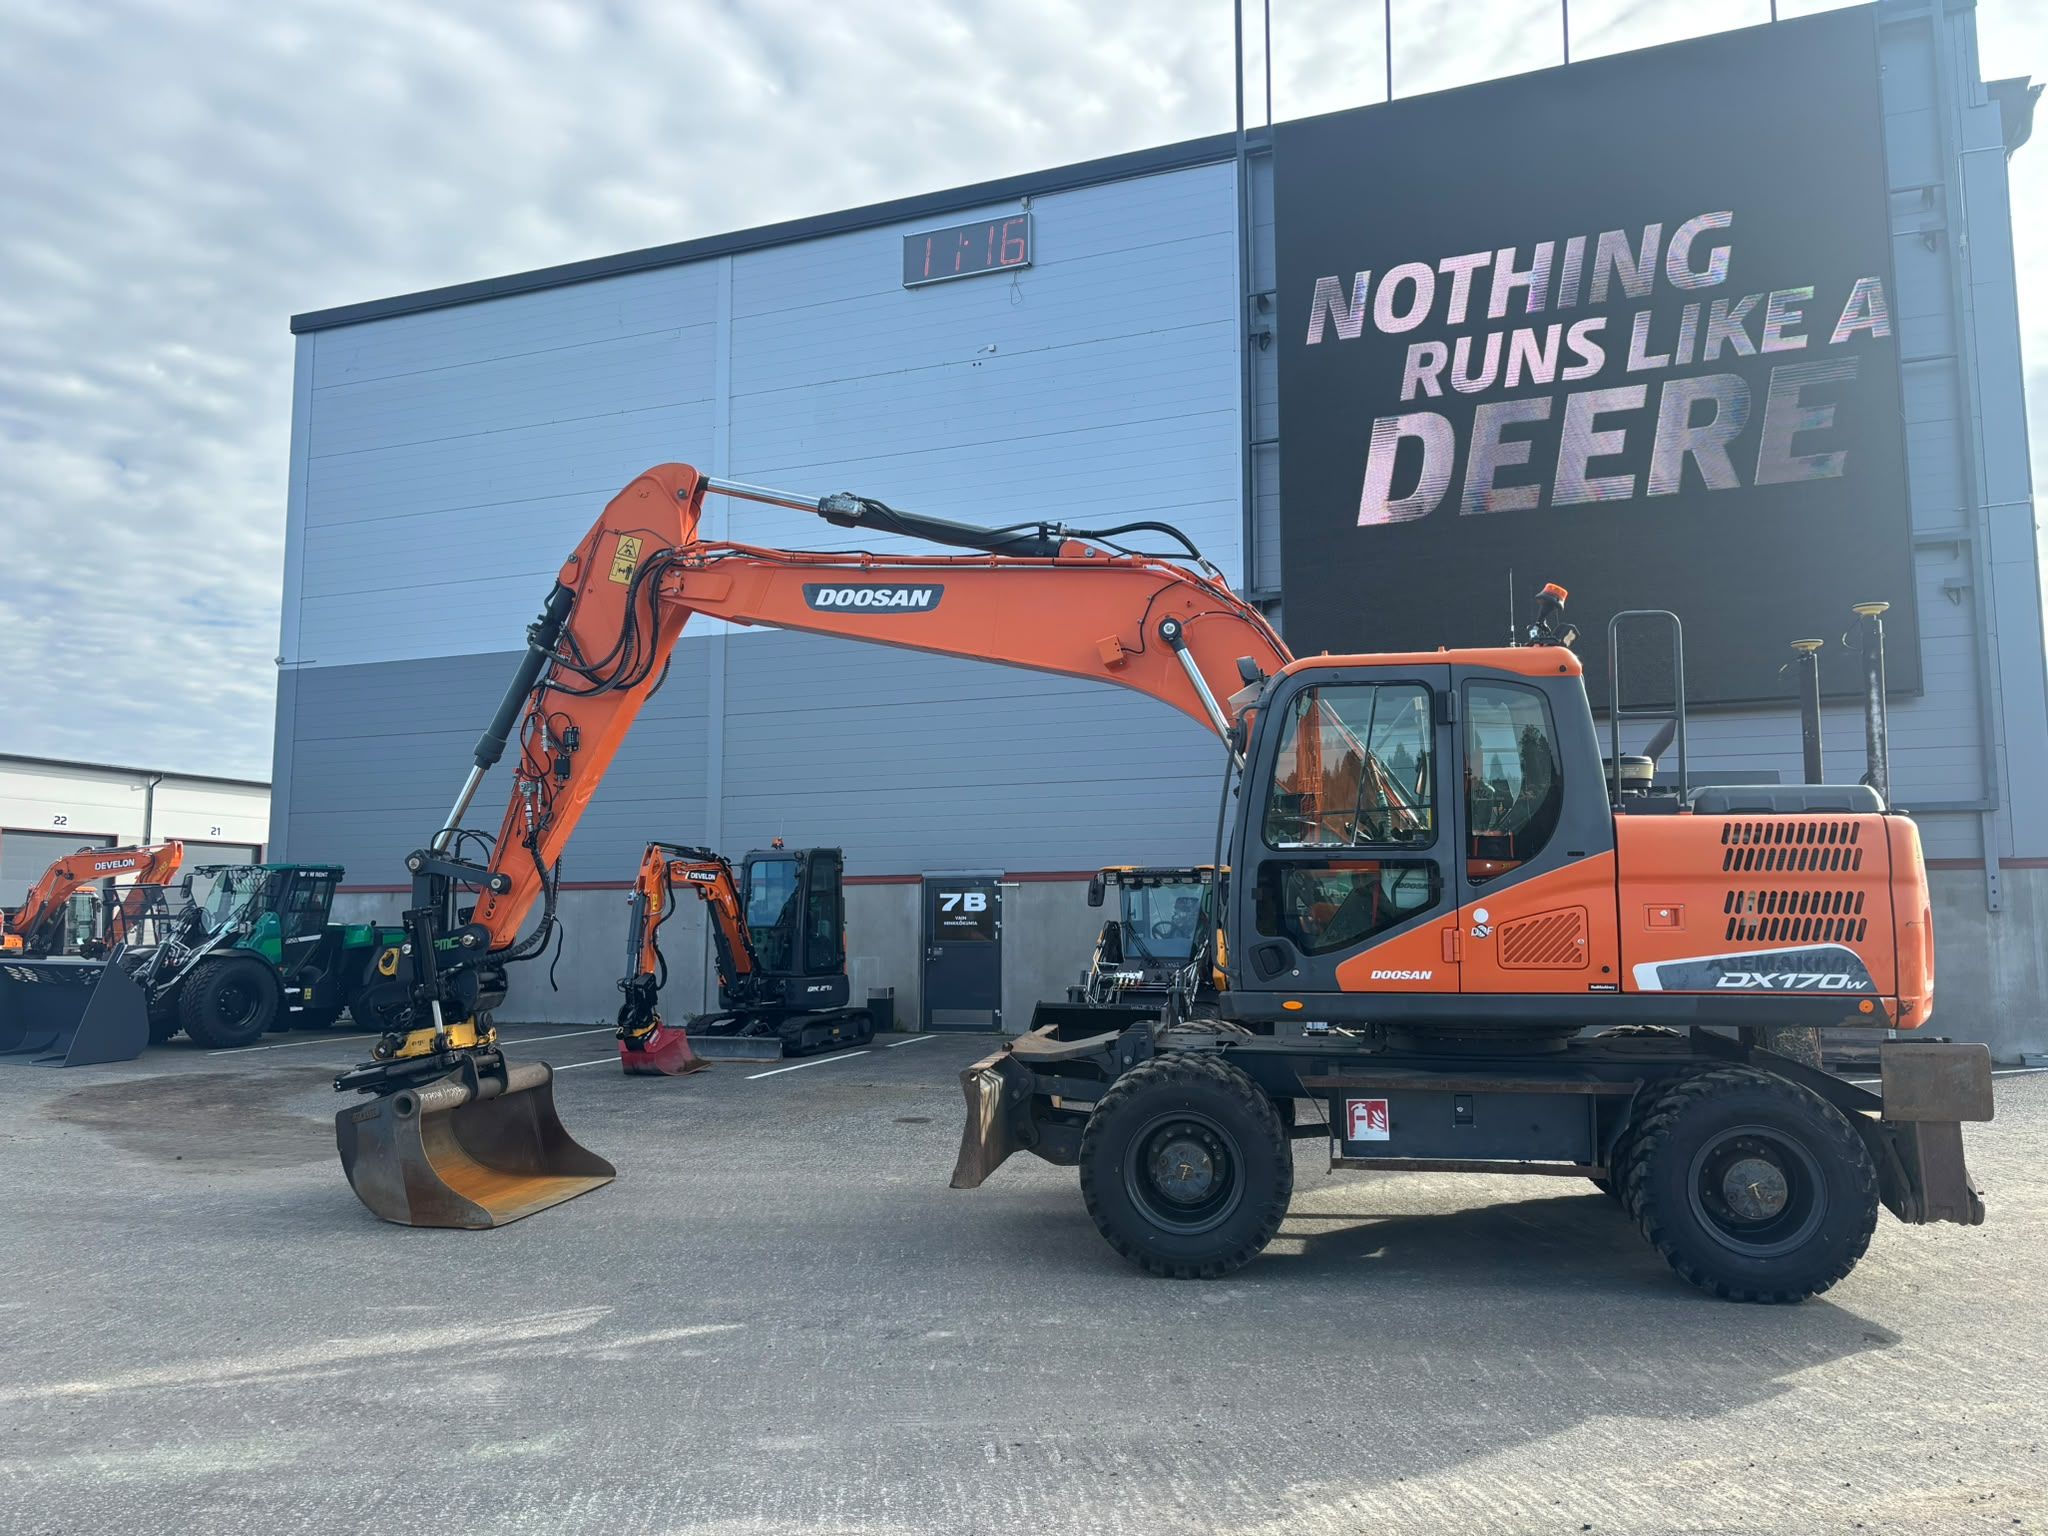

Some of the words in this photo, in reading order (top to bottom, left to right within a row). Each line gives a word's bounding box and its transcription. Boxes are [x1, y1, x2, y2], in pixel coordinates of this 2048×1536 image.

[1306, 210, 1733, 345] NOTHING
[1400, 317, 1607, 401] RUNS
[1627, 286, 1815, 373] LIKE
[1829, 276, 1892, 344] A
[1357, 356, 1859, 527] DEERE
[815, 589, 932, 606] DOOSAN
[53, 815, 67, 826] 22
[210, 827, 221, 836] 21
[95, 859, 135, 871] DEVELON
[690, 872, 716, 881] DEVELON
[939, 892, 987, 912] 7B
[1370, 969, 1433, 980] DOOSAN
